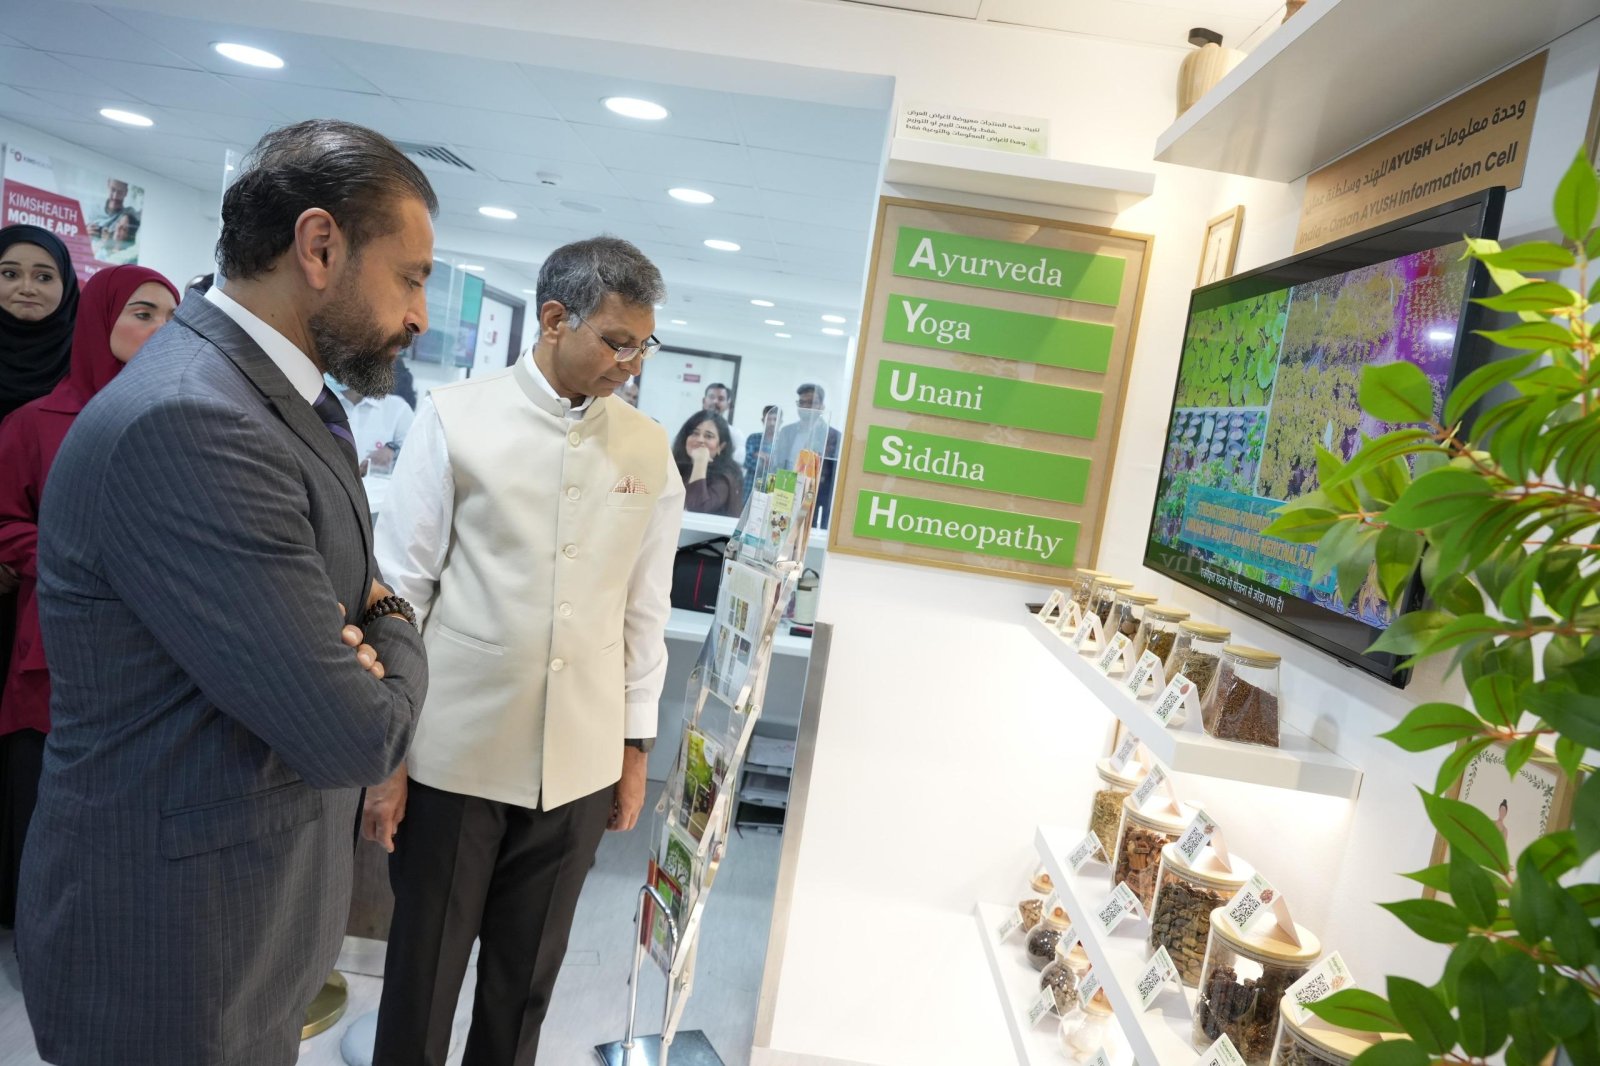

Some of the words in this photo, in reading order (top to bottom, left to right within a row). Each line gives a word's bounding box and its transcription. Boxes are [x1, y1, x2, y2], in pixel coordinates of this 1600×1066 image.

[1491, 99, 1526, 126] وحدة
[1435, 117, 1489, 152] معلومات
[1362, 159, 1389, 187] للهند
[1388, 138, 1434, 174] AYUSH
[8, 191, 78, 222] KIMSHEALTH
[1299, 225, 1321, 244] India
[1329, 210, 1360, 233] Oman
[1361, 191, 1399, 222] AYUSH
[1397, 160, 1482, 208] Information
[1484, 141, 1519, 172] Cell
[8, 208, 54, 233] MOBILE
[54, 221, 79, 237] APP
[908, 237, 1063, 288] Ayurveda
[901, 300, 971, 345] Yoga
[889, 369, 984, 411] Unani
[879, 435, 985, 482] Siddha
[868, 496, 1063, 559] Homeopathy
[1262, 538, 1298, 565] MEDICINAL
